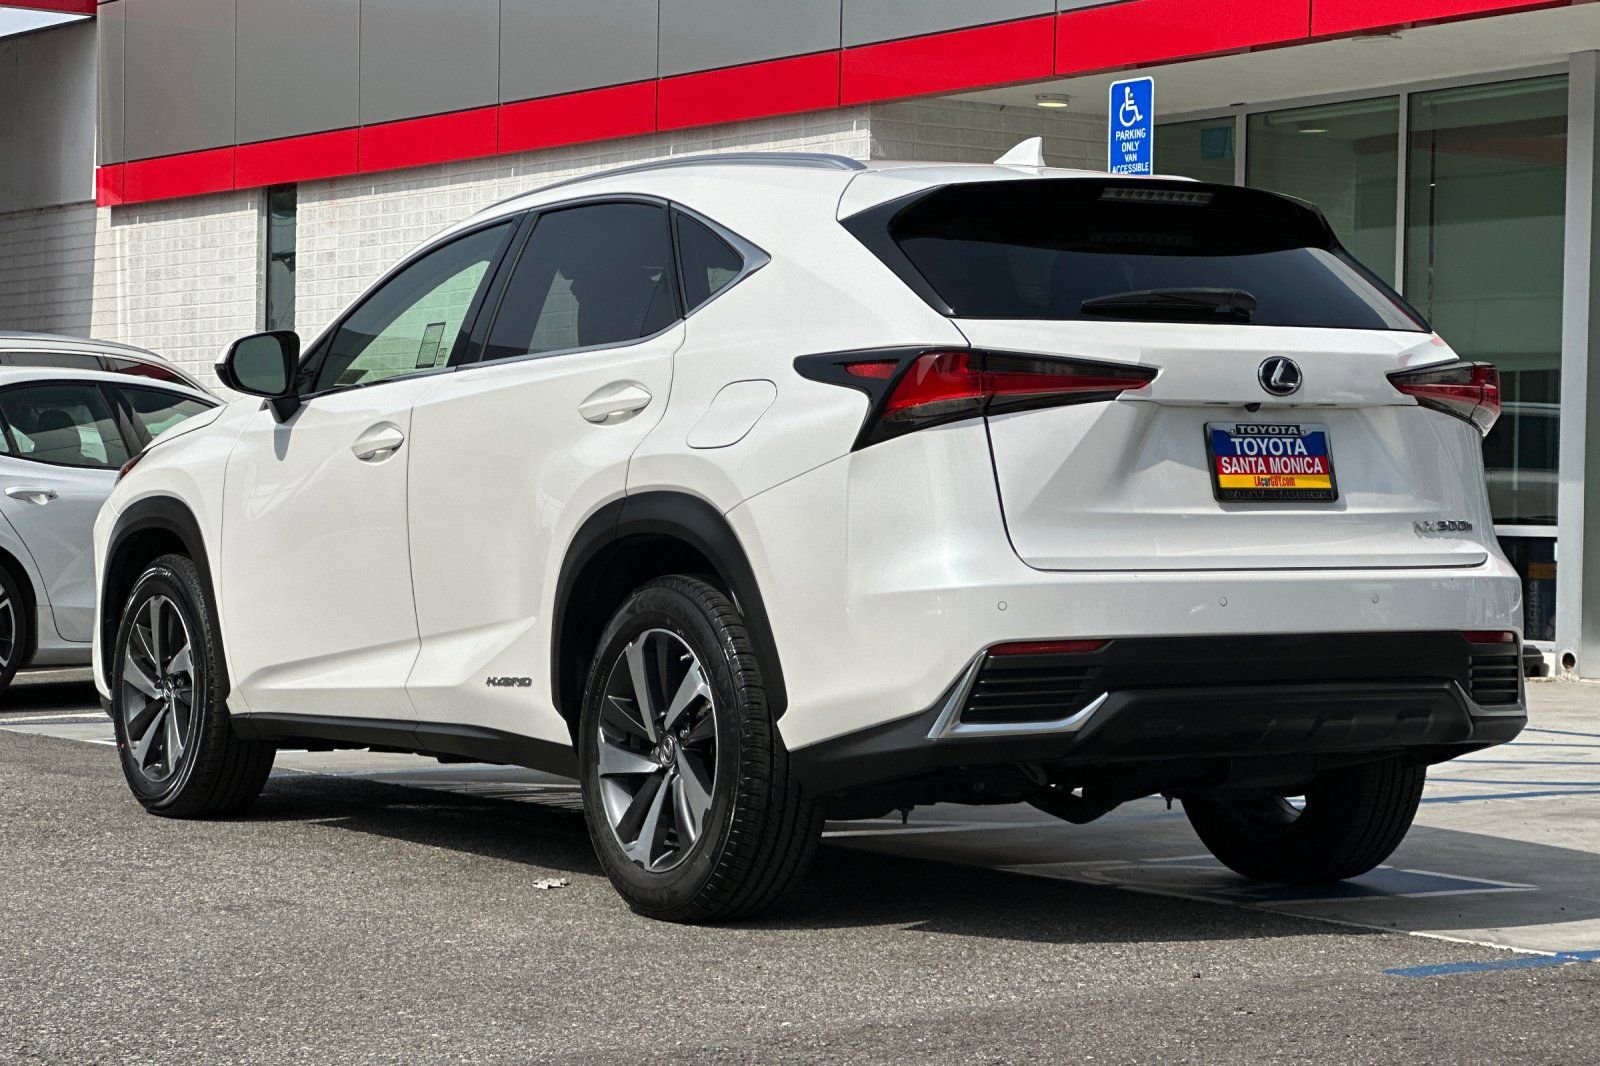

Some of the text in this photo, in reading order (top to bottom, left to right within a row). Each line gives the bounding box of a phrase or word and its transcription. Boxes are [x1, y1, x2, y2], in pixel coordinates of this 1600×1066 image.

[1115, 128, 1146, 141] PARKING
[1121, 141, 1140, 152] ONLY
[1124, 153, 1137, 162] VAN
[1112, 162, 1149, 174] ACCESSIBLE
[1237, 425, 1299, 434] TOYOTA
[1231, 438, 1308, 455] TOYOTA
[1222, 457, 1323, 474] SANTA MONICA
[486, 676, 532, 687] HYBRID
